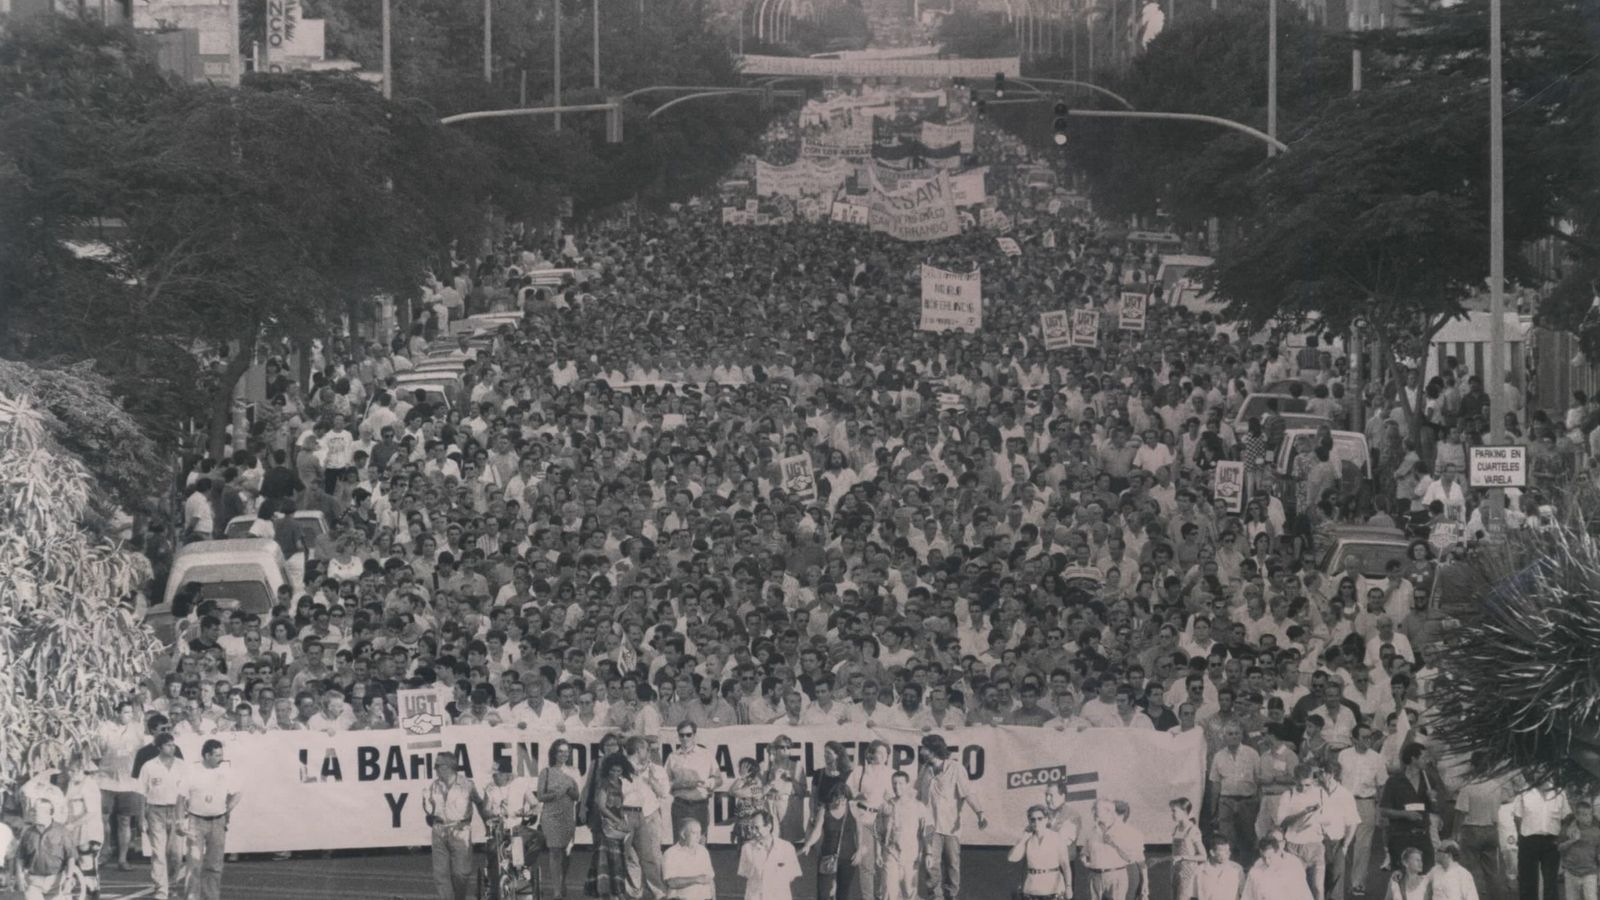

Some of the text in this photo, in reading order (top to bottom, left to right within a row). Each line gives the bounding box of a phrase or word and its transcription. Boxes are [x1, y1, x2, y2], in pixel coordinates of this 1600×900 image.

[1475, 449, 1522, 459] PARKING EN
[786, 460, 809, 481] UGT
[1219, 466, 1240, 485] UGT
[1477, 461, 1520, 472] CUARTELES
[1484, 475, 1513, 485] VARELA
[404, 694, 437, 718] UGT
[299, 748, 342, 783] LA
[493, 742, 539, 777] EN
[1010, 768, 1066, 787] CC.OO.
[384, 793, 409, 828] Y
